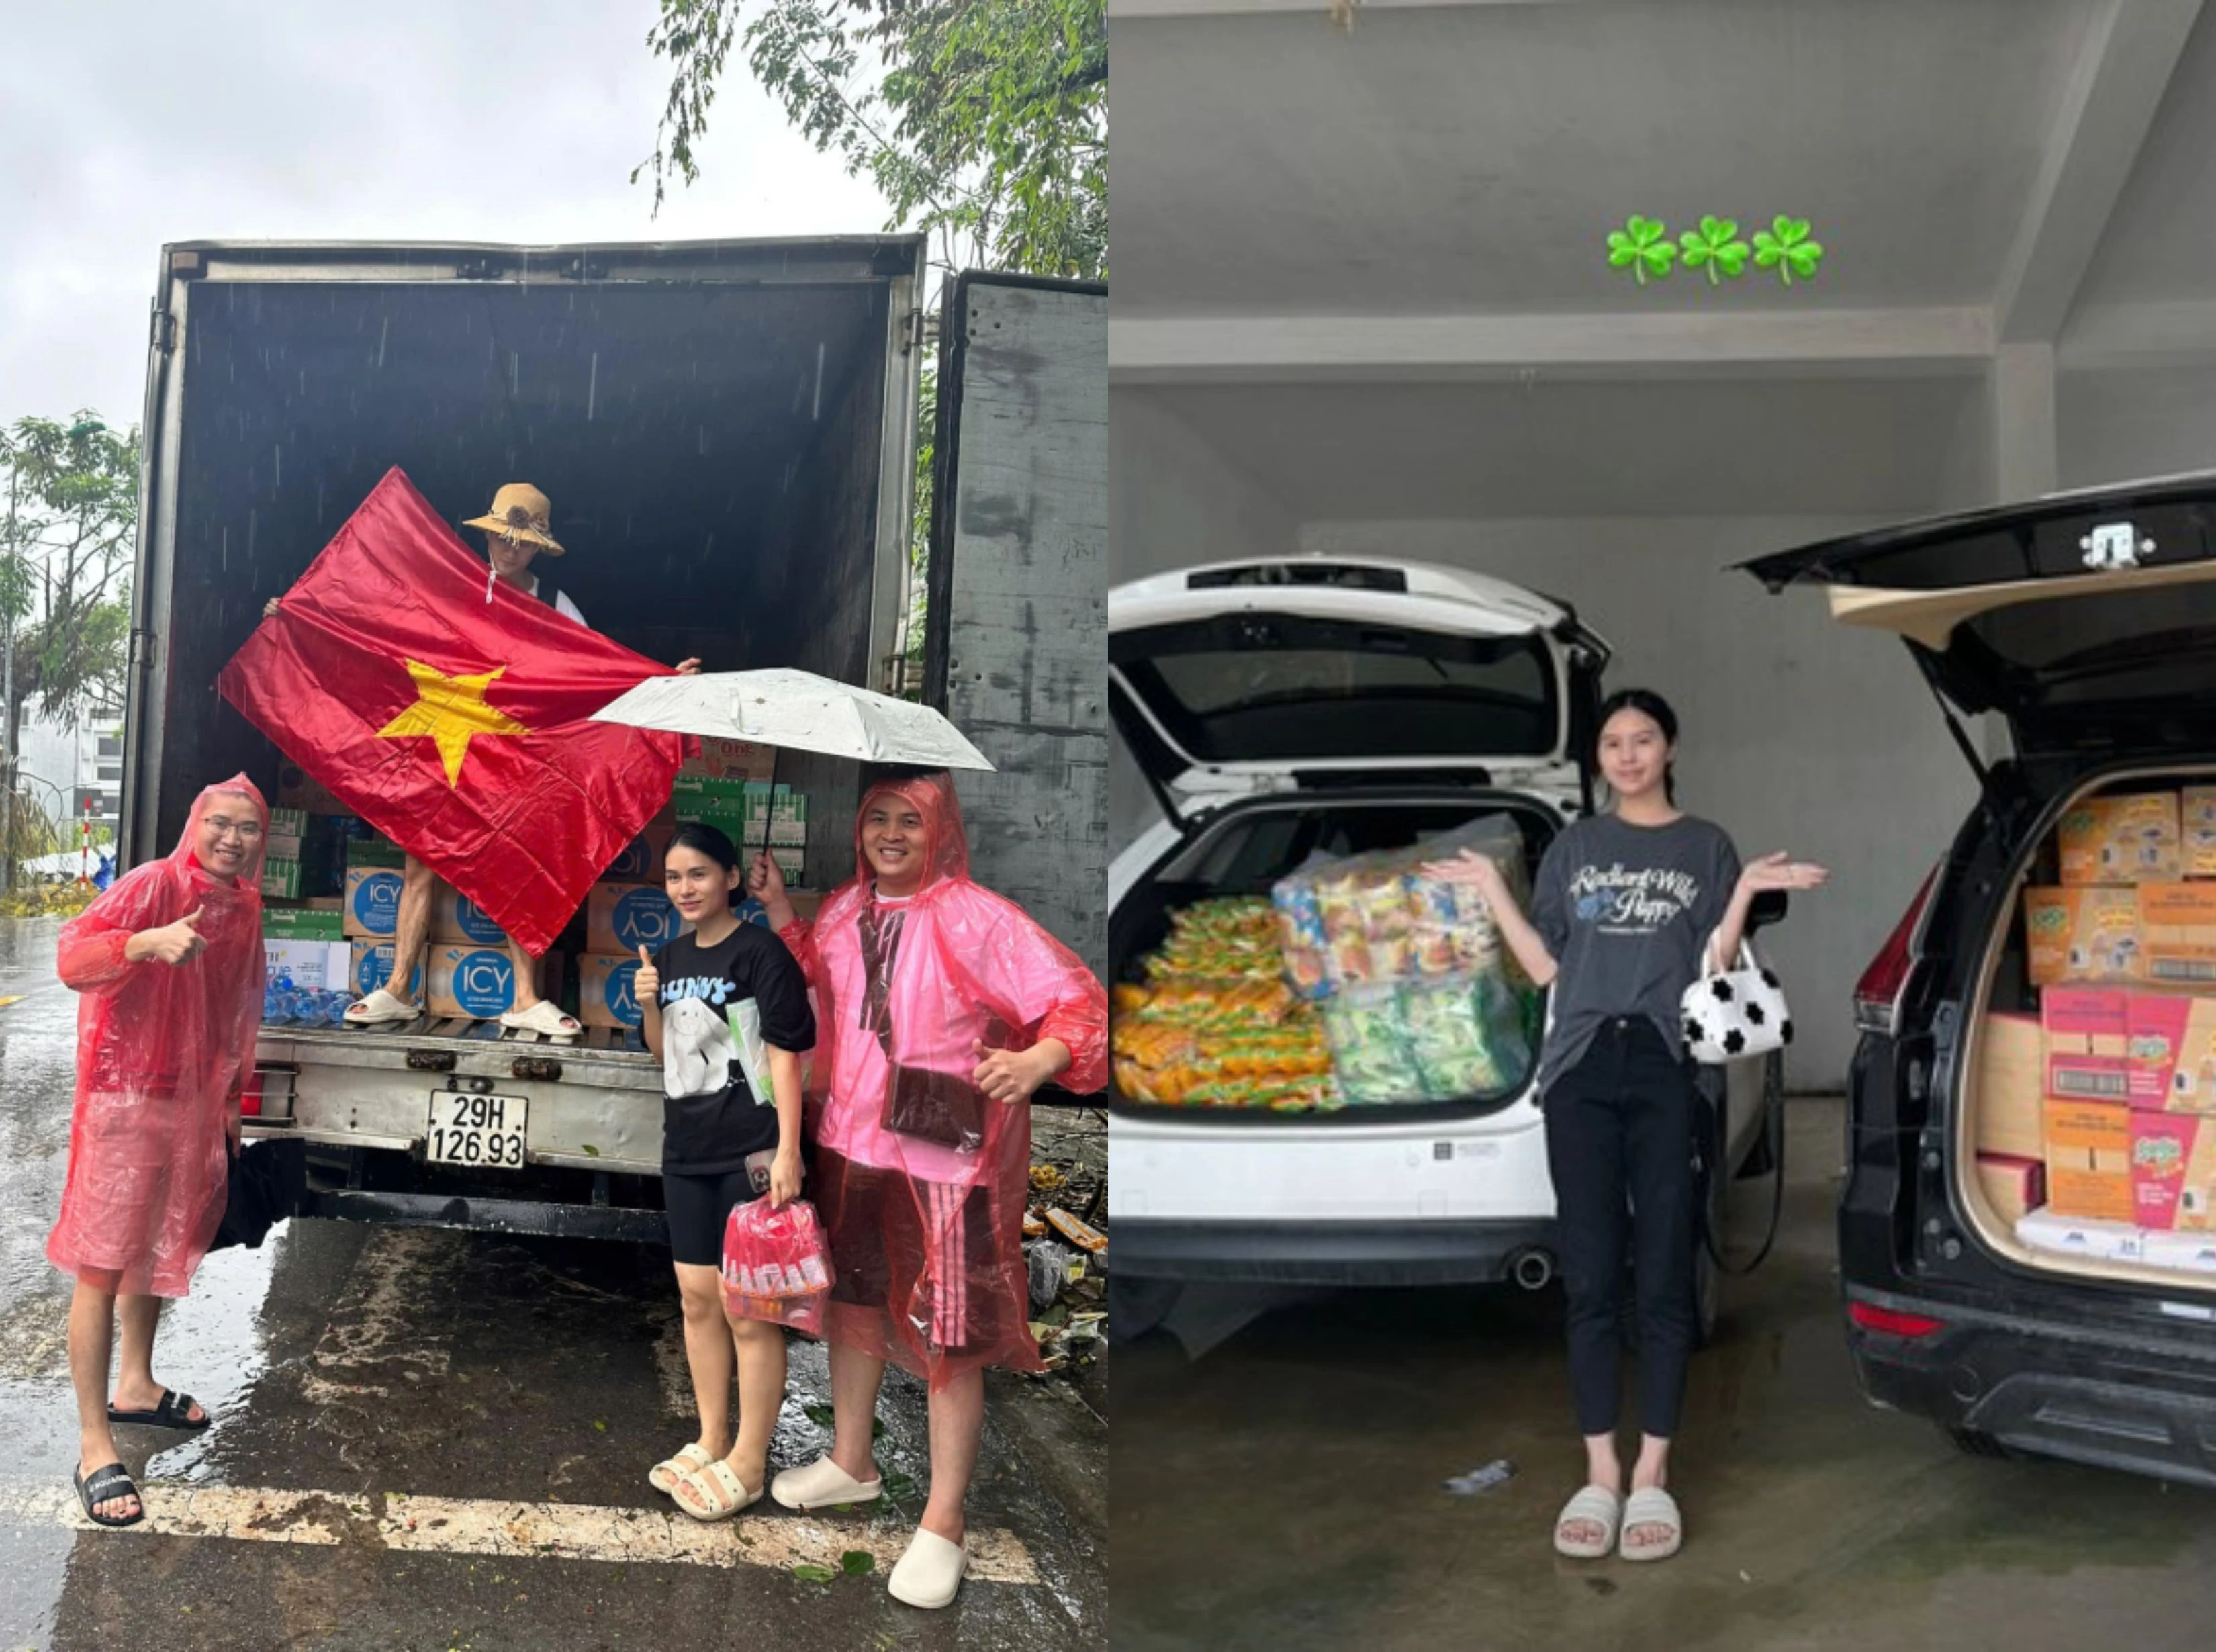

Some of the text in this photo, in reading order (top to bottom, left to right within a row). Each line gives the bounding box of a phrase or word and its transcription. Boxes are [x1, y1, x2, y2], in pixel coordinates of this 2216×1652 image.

[369, 884, 401, 903] ICY
[622, 911, 670, 939] ICY
[463, 965, 511, 994] ICY
[661, 976, 737, 1004] UNNY
[452, 1095, 504, 1130] 29H
[434, 1128, 522, 1166] 126.93
